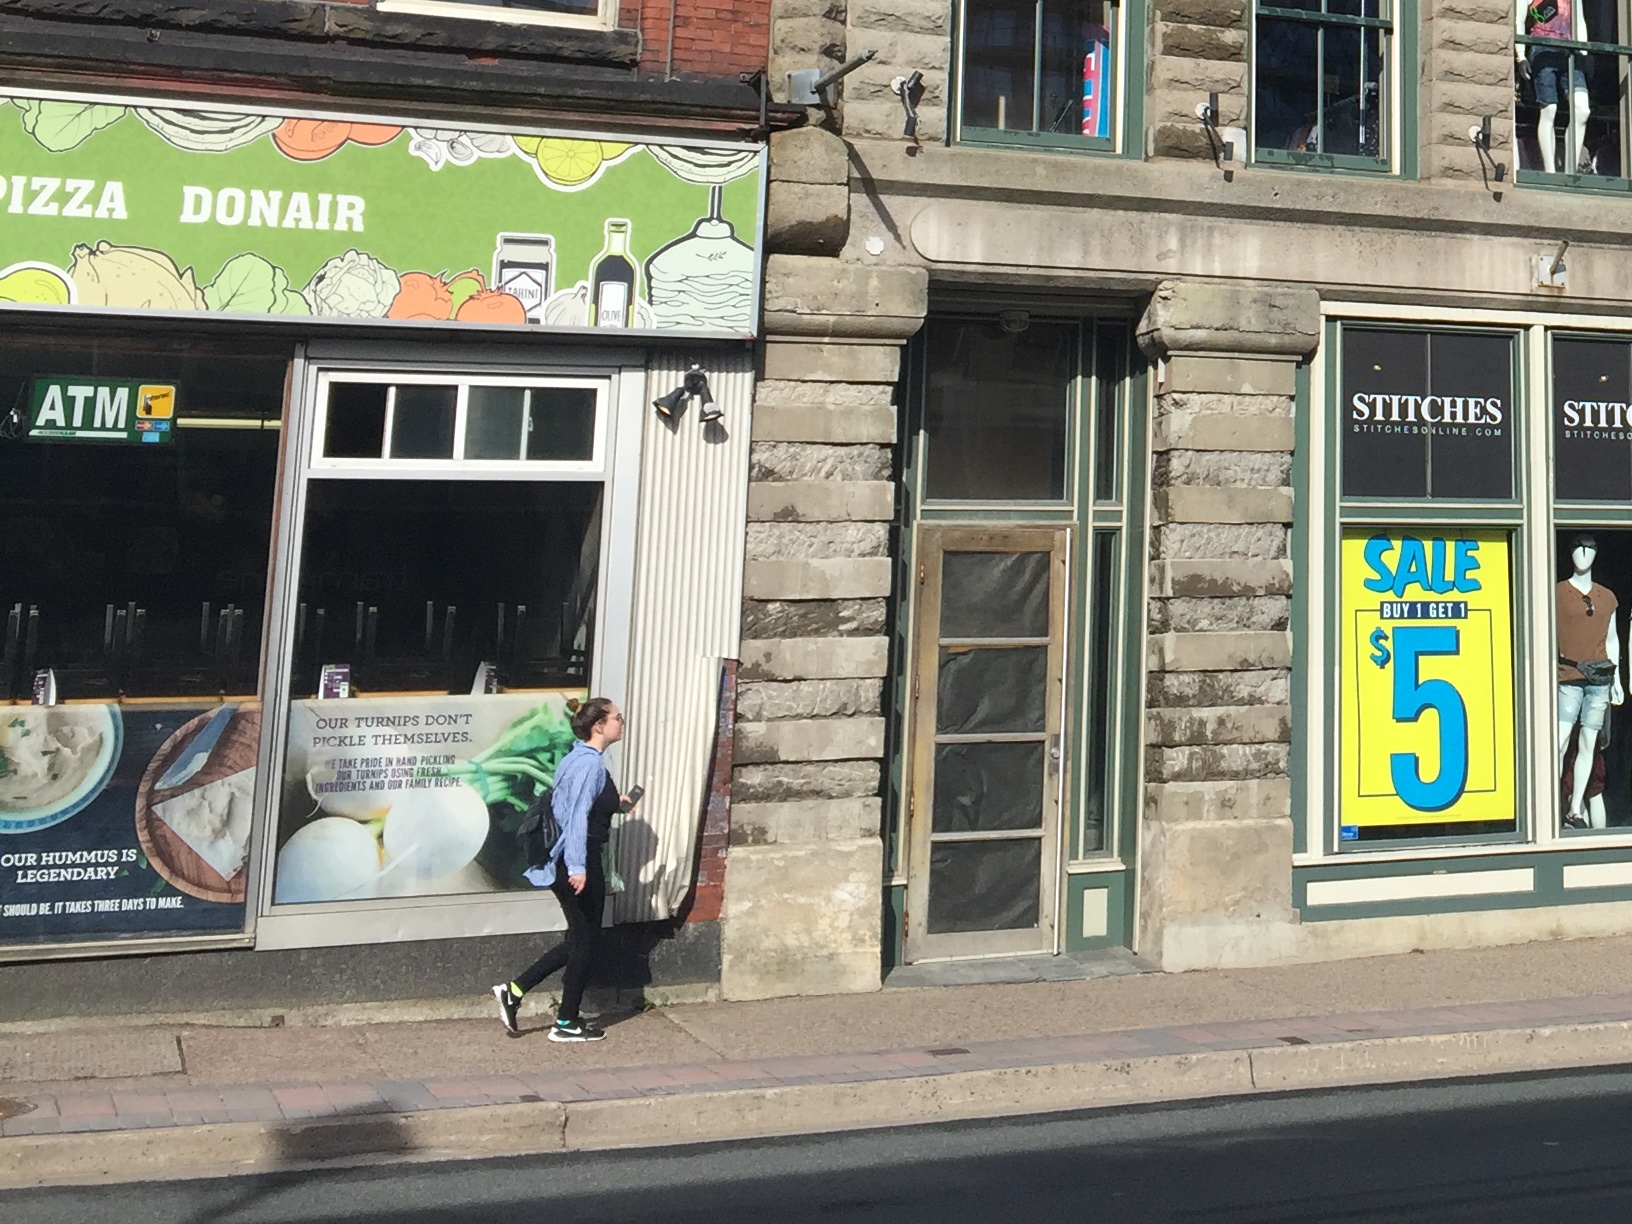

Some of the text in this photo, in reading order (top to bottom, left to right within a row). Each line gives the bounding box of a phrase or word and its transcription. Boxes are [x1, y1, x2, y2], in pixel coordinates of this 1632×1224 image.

[0, 176, 365, 232] IZZA DONAIR
[35, 385, 129, 428] ATM
[1352, 393, 1502, 425] STITCHES
[1353, 425, 1502, 437] STITCHESONLINE.COM
[1363, 534, 1482, 599] SALE
[1383, 603, 1465, 618] BUY 1 GET 1
[316, 713, 473, 729] OUR TURNIPS DON'T
[1370, 626, 1469, 812] $5
[313, 731, 473, 747] PICKLE THEMSELVES.
[339, 757, 358, 769] TAKE
[360, 757, 382, 768] PRIDE
[385, 756, 393, 766] IN
[396, 756, 417, 766] HAND
[421, 754, 455, 765] PICKLING
[336, 767, 441, 781] OUR TURNIPS USING FRESH
[315, 780, 366, 794] INGREDIENTS
[369, 780, 385, 790] AND
[388, 779, 402, 790] OUR
[404, 778, 432, 789] FAMILY
[1, 849, 137, 867] OUR HUMMUS IS
[16, 866, 119, 883] LEGENDARY
[3, 903, 37, 917] SHOULD
[38, 902, 52, 915] BE.
[54, 902, 64, 914] IT
[65, 900, 92, 914] TAKES
[93, 898, 120, 912] THREE
[121, 897, 144, 911] DAYS
[145, 897, 156, 909] TO
[157, 896, 184, 909] MAKE.
